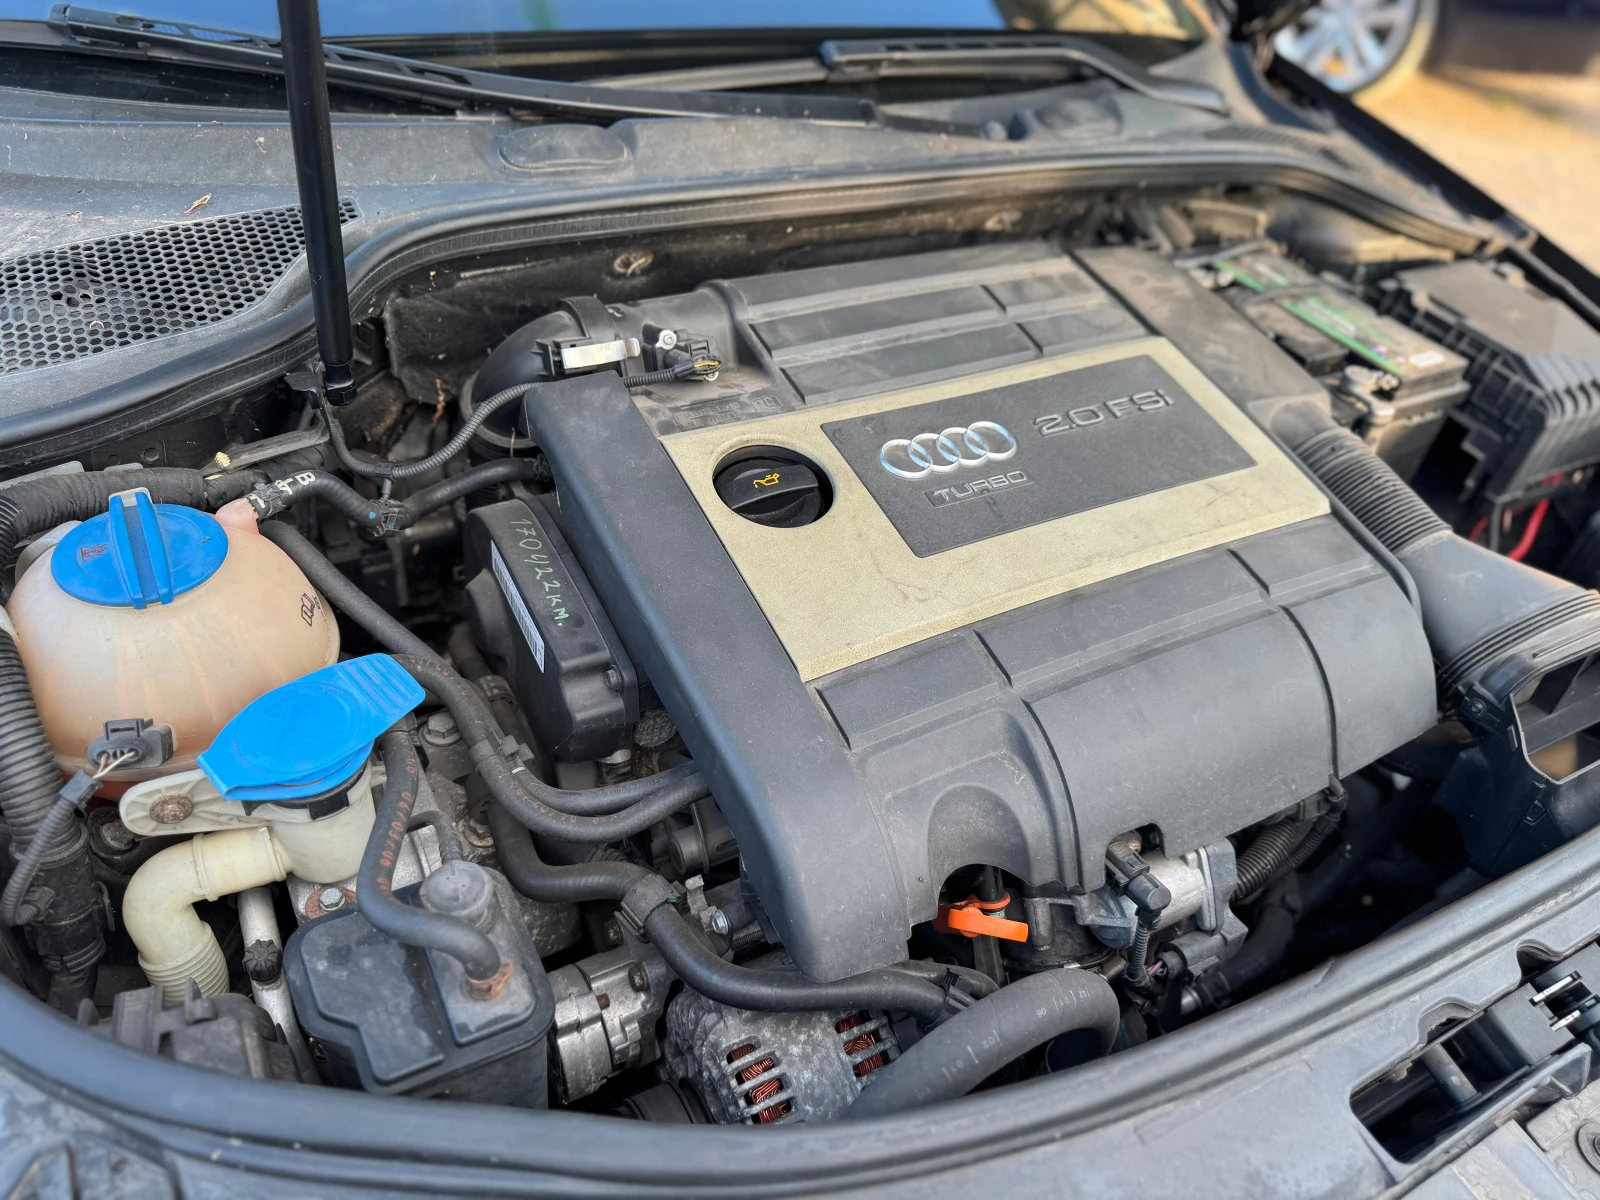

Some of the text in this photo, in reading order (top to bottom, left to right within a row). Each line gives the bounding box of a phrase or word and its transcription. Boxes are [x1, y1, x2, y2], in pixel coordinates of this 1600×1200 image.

[1033, 388, 1175, 437] 2.0 FSI
[932, 469, 1028, 501] TURBO
